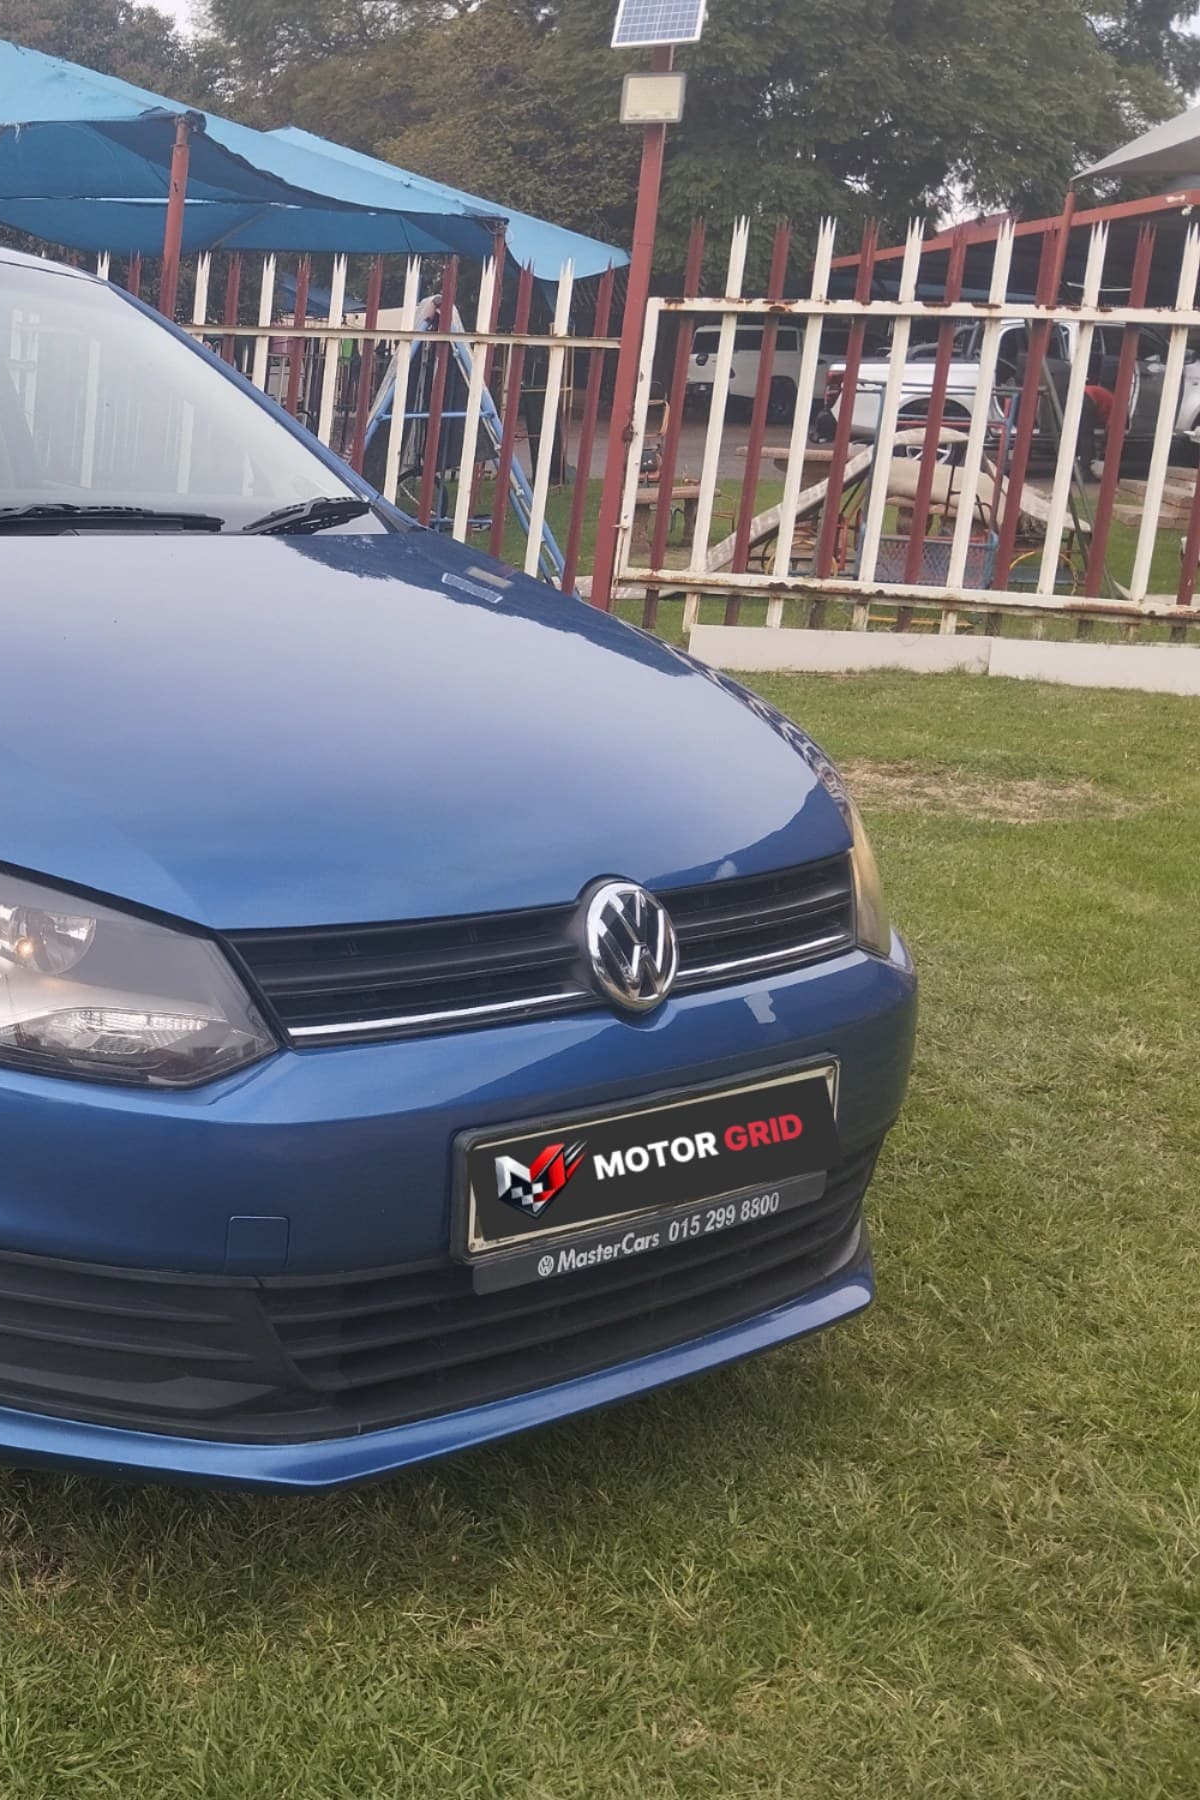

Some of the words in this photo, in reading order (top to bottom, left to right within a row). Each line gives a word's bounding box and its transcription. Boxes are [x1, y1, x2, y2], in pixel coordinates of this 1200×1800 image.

[557, 1232, 660, 1273] MasterCars
[668, 1214, 701, 1242] 015
[704, 1204, 736, 1232] 299
[740, 1192, 780, 1222] 8800
